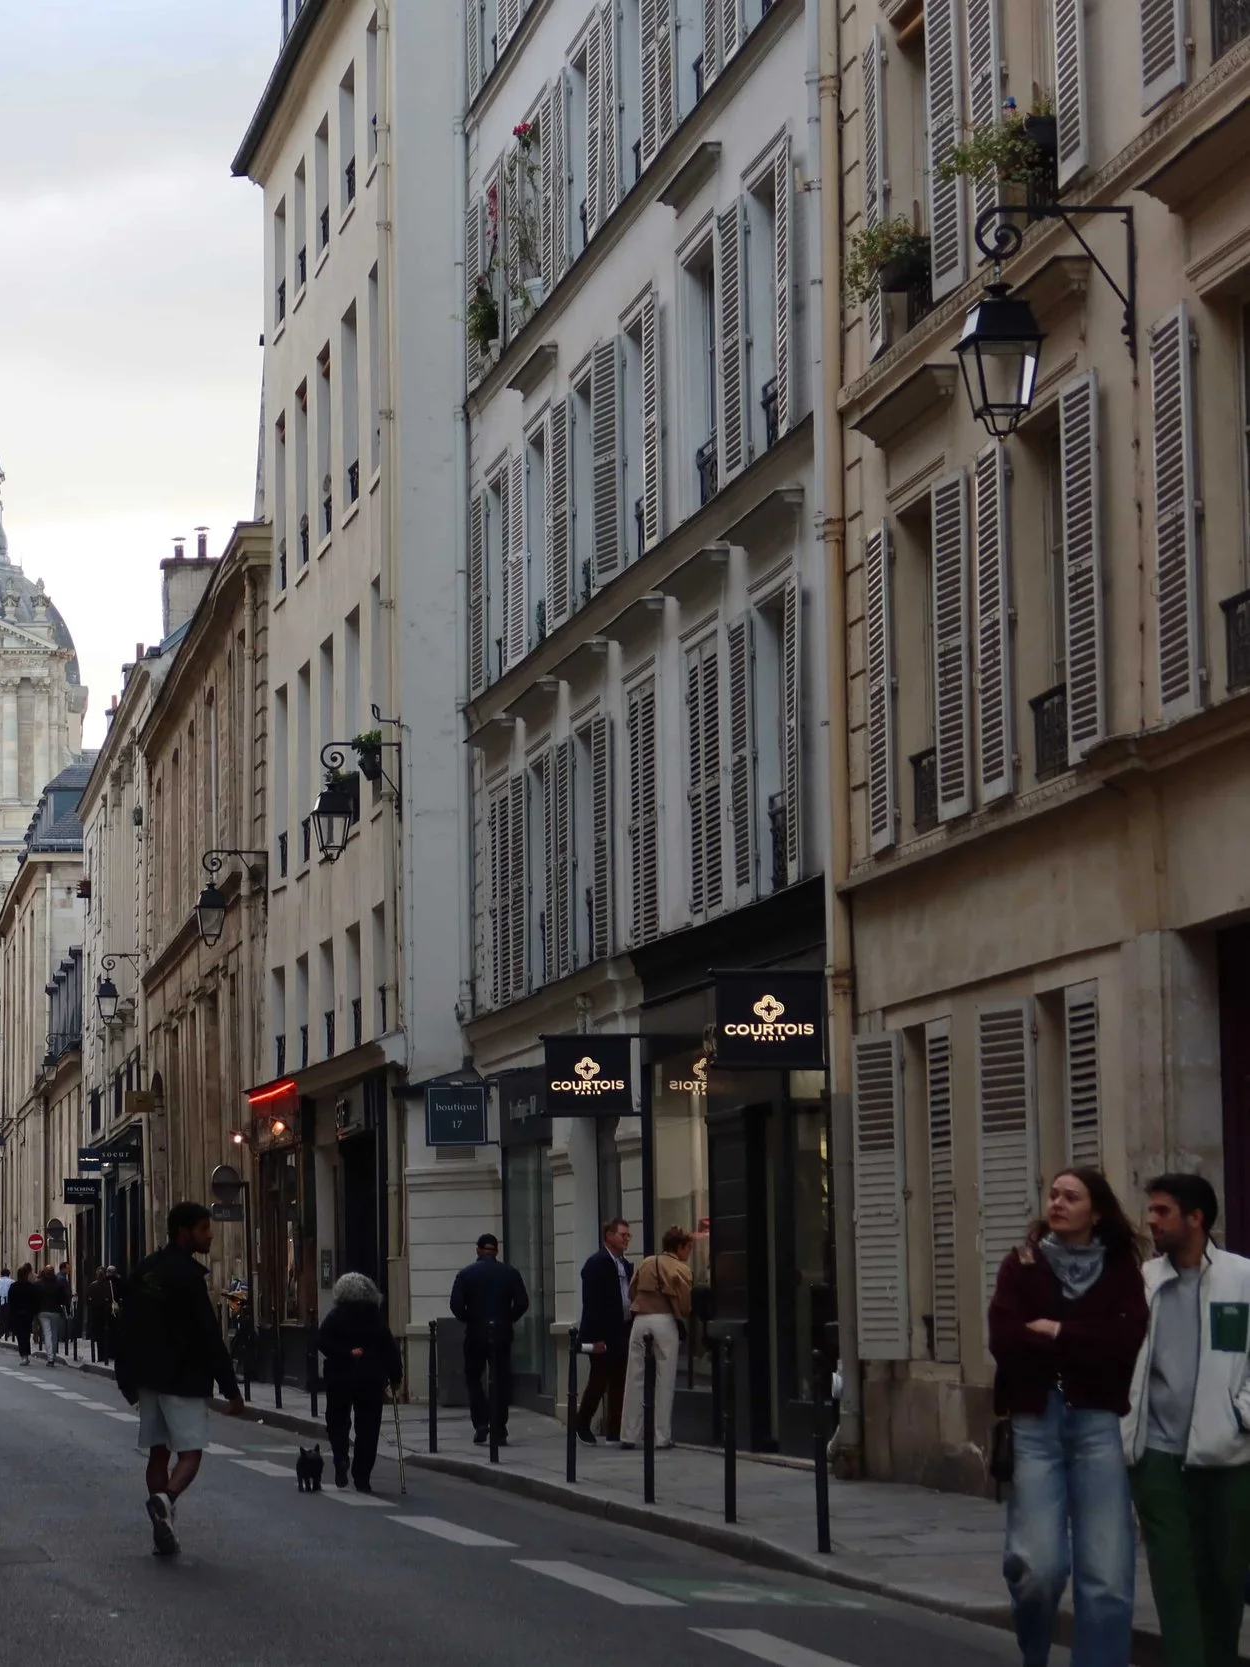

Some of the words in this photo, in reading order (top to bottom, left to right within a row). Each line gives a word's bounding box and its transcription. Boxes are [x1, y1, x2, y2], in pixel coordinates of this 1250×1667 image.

[724, 1023, 815, 1035] COURTOIS
[551, 1080, 625, 1091] COURTOIS
[435, 1102, 478, 1113] boutique
[451, 1120, 463, 1129] 17
